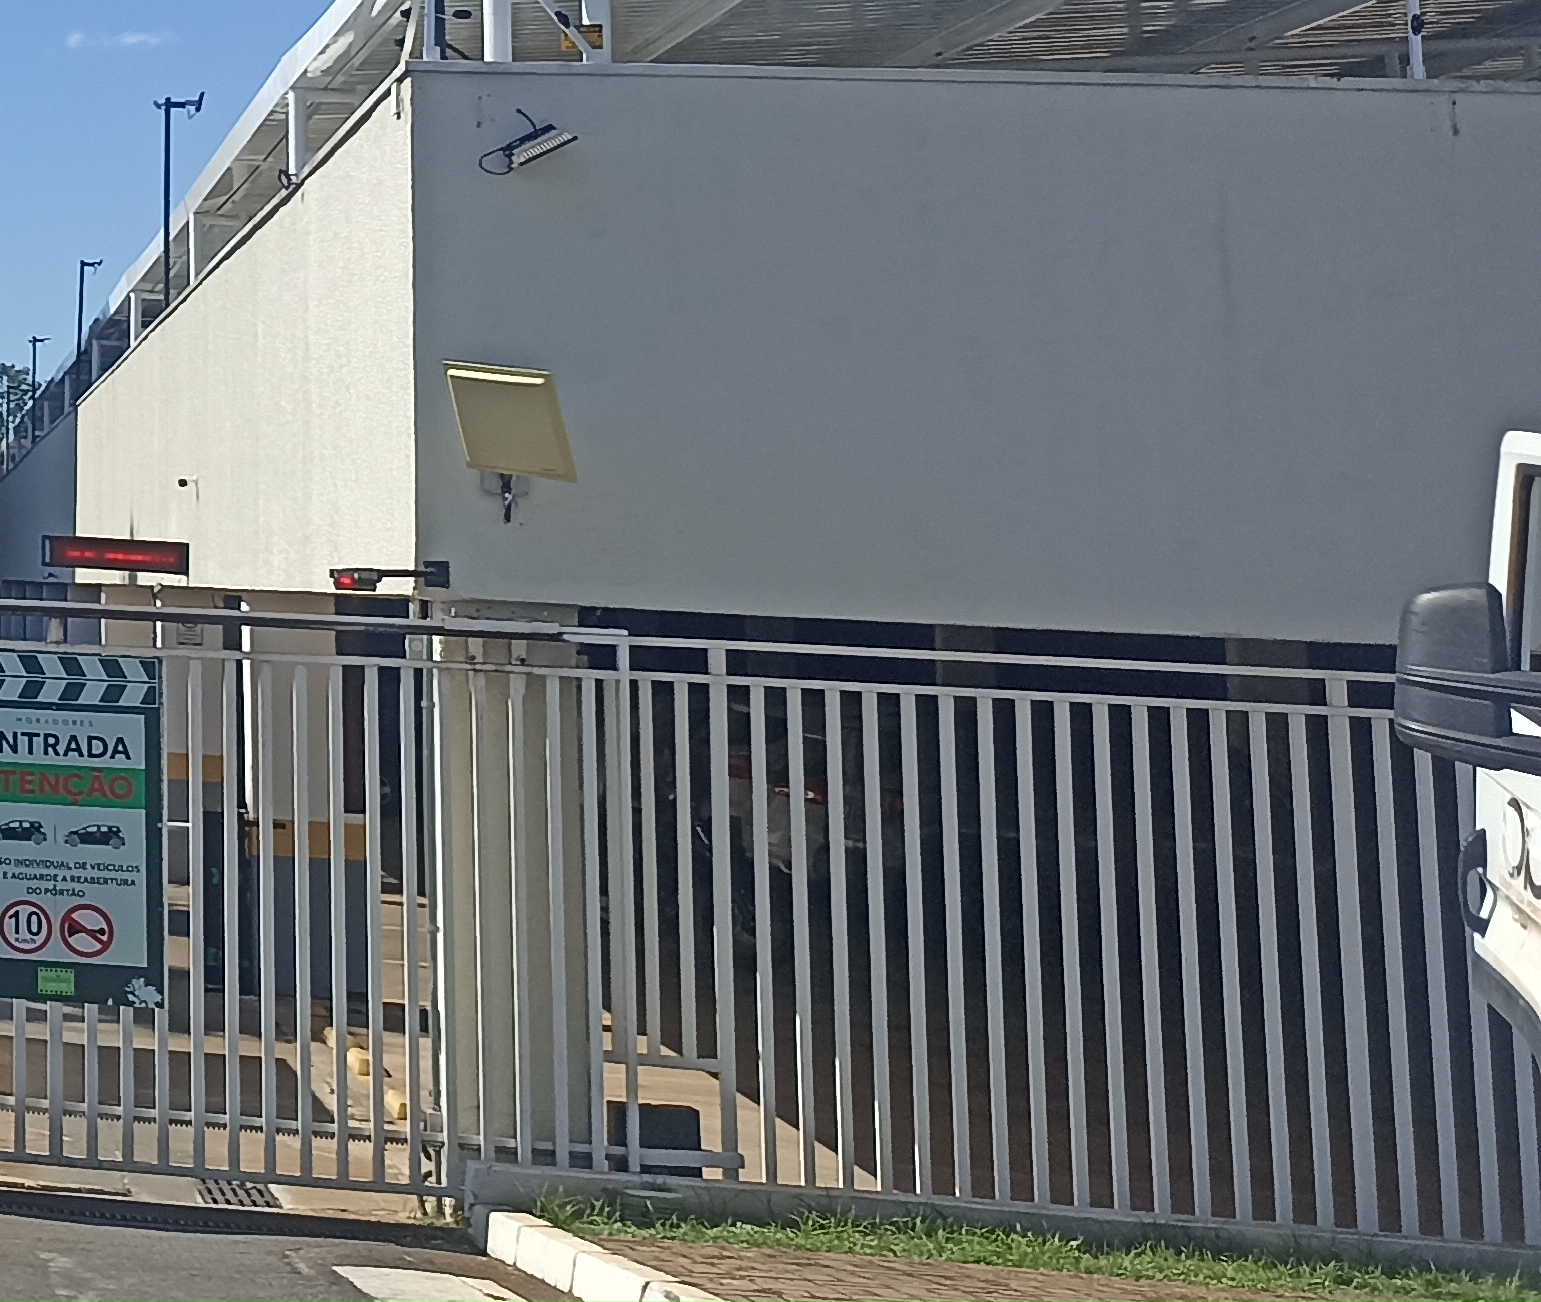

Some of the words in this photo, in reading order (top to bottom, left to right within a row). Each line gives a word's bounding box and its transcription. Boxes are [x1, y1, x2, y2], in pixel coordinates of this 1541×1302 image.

[16, 717, 93, 727] MORADORES
[13, 858, 72, 870] INDIVIDUAL
[74, 861, 88, 870] DE
[3, 871, 8, 879] E
[10, 872, 59, 882] AGUARDE
[70, 874, 136, 886] REABERTURA
[26, 886, 42, 895] DO
[8, 909, 43, 937] 10
